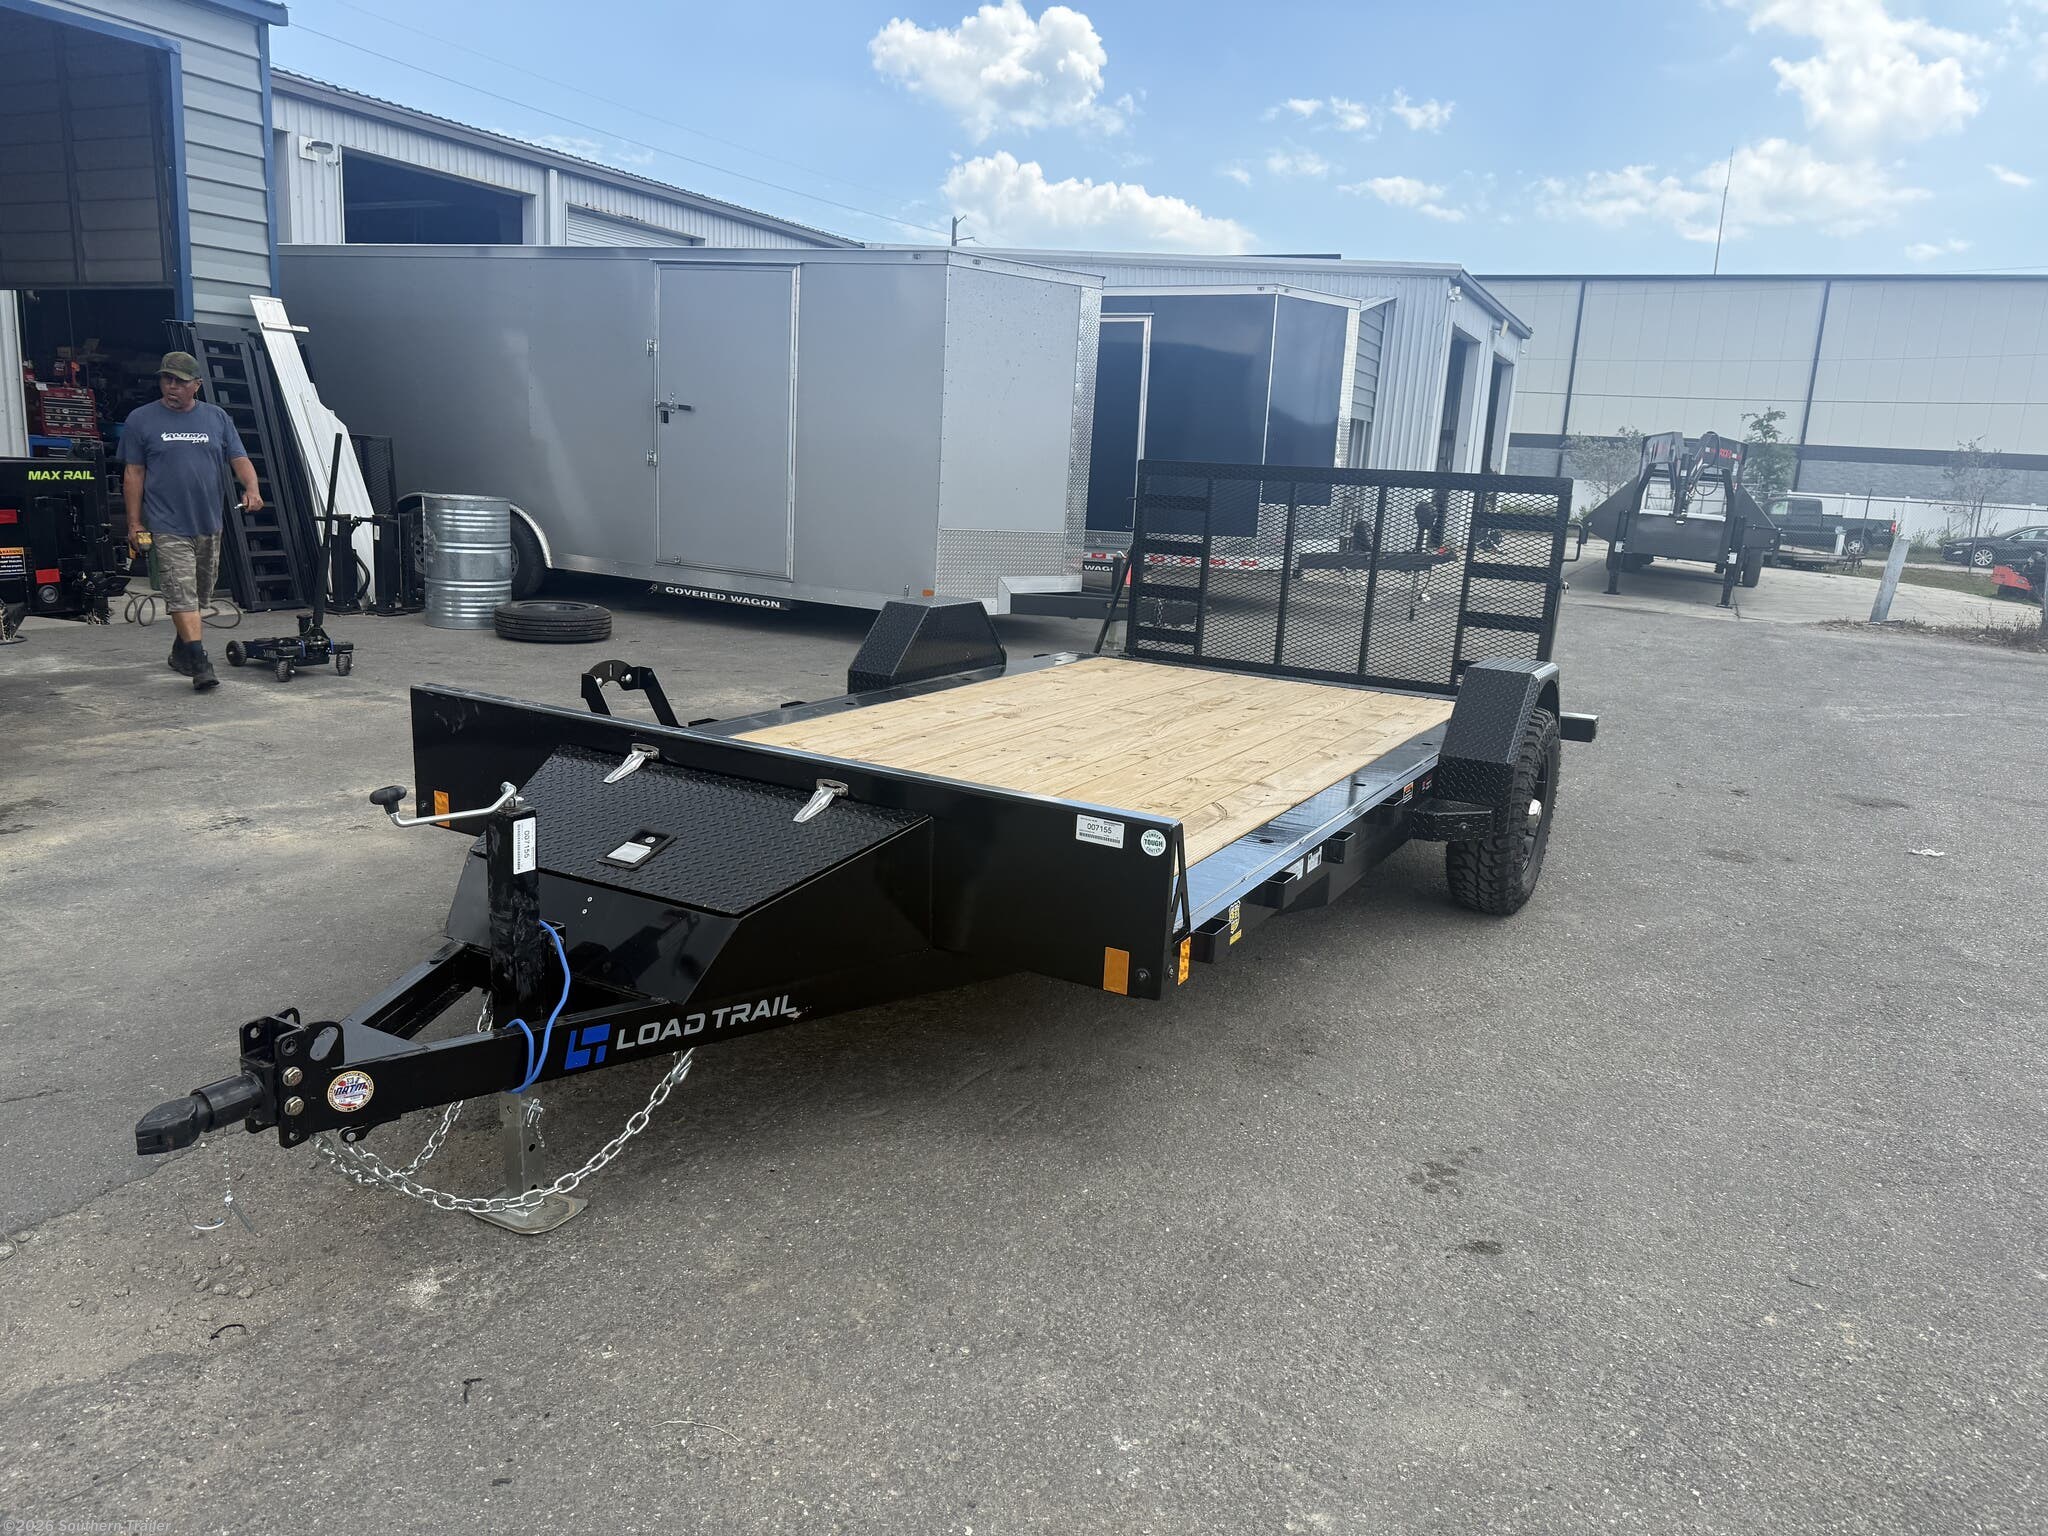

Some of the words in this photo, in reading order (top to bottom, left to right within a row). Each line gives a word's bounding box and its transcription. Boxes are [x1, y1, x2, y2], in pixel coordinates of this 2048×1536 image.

[28, 470, 61, 480] MAX
[63, 470, 95, 480] RAIL
[1084, 564, 1114, 572] WAG
[665, 585, 727, 601] COVERED
[730, 594, 781, 609] WAGON
[1086, 822, 1113, 834] 007155
[1143, 838, 1163, 848] TOUGH
[616, 1012, 706, 1050] LOAD
[711, 994, 797, 1029] TRAIL
